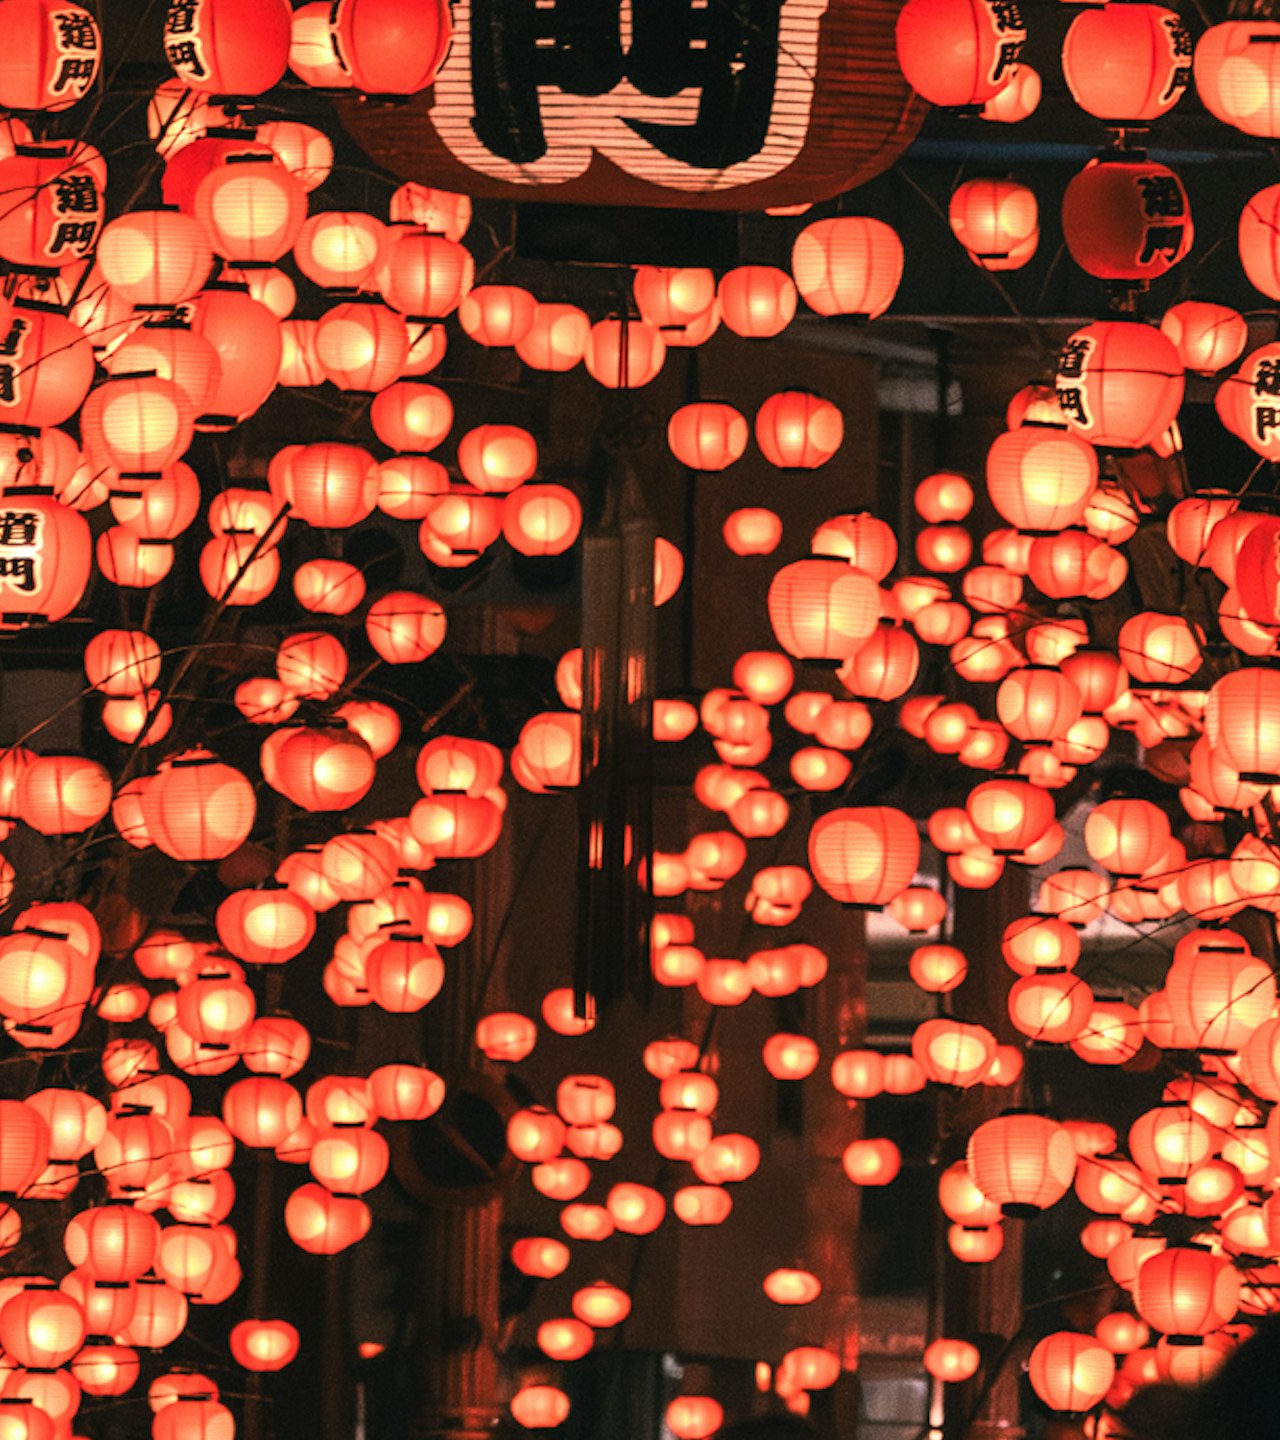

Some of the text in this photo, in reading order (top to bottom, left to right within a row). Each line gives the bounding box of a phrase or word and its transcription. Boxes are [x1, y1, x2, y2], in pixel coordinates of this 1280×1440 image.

[54, 13, 98, 92] 道門
[54, 176, 97, 254] 道門
[1136, 177, 1183, 263] 道門
